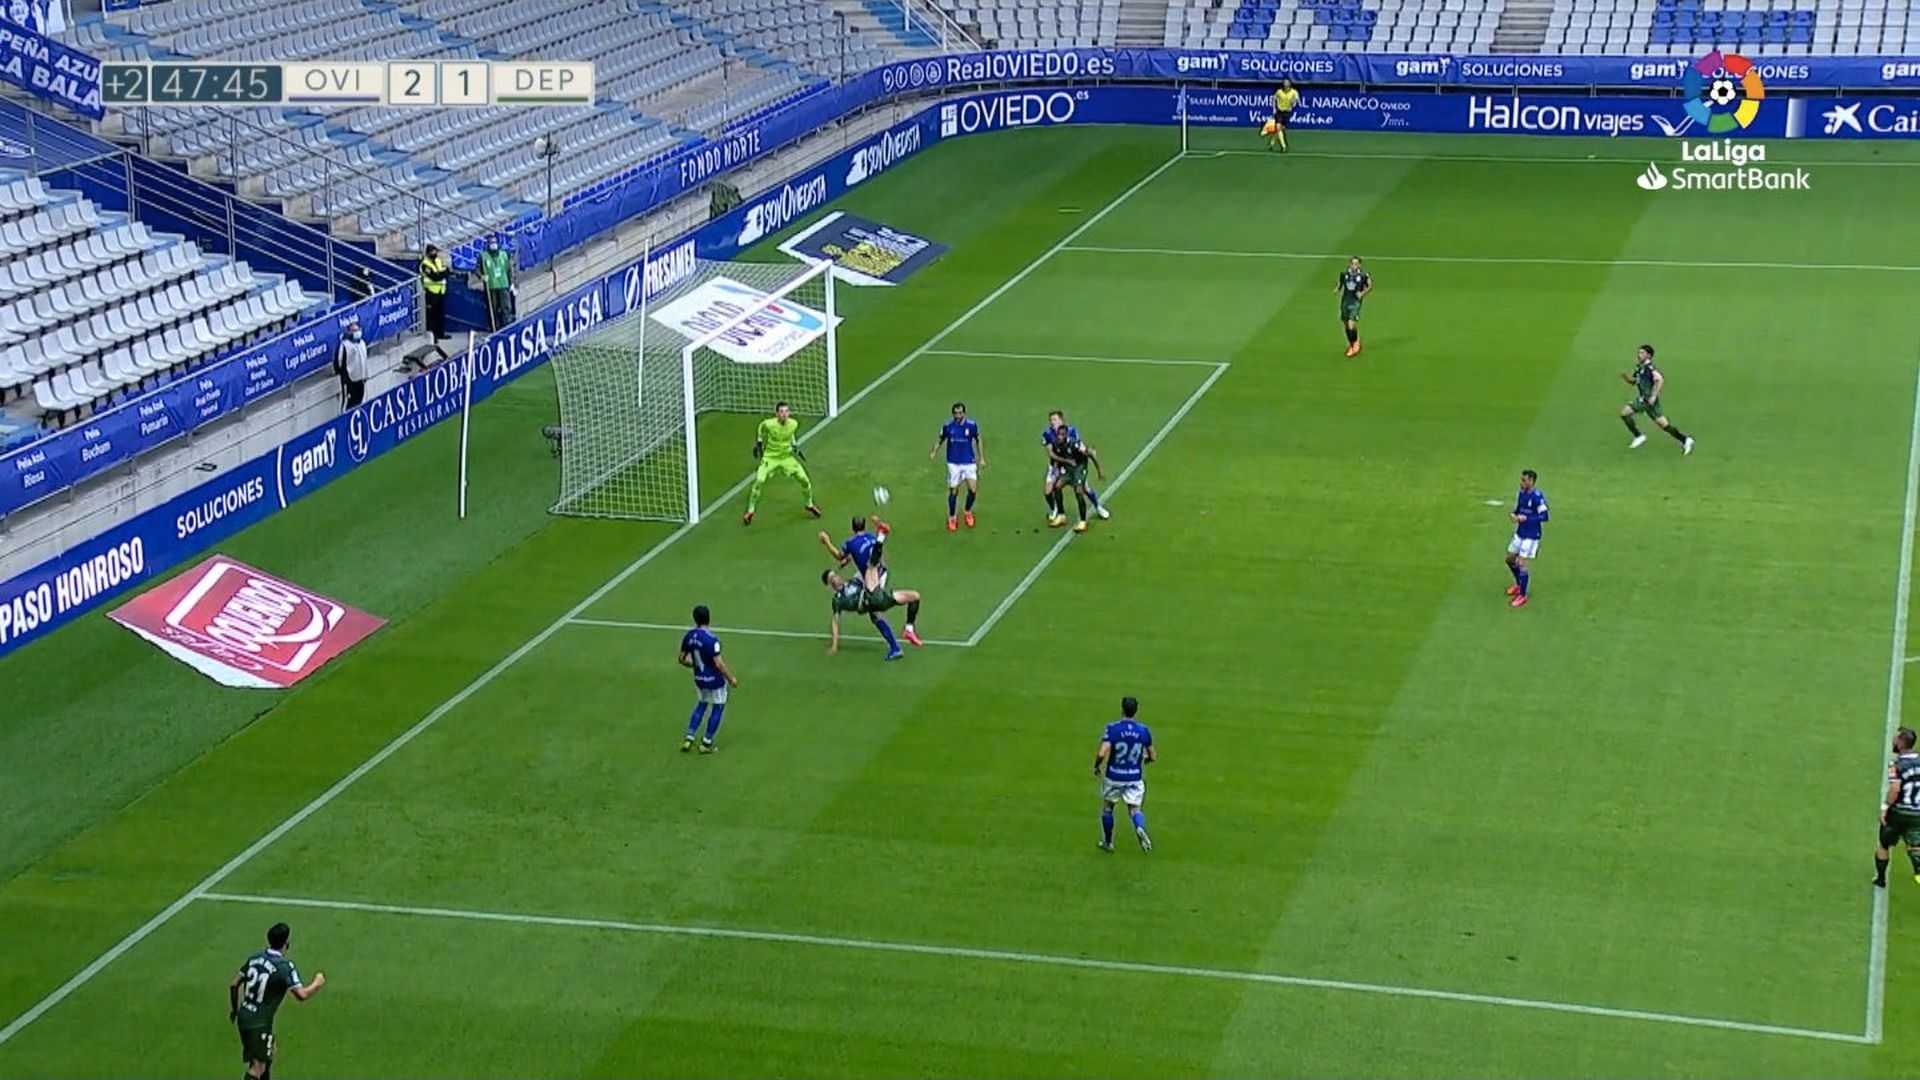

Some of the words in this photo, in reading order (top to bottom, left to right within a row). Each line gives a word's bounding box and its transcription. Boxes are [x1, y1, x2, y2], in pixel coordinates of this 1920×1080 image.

[0, 29, 49, 63] PEÑA
[55, 54, 101, 85] AZU
[947, 52, 1115, 83] RealOVIEDO.es
[1241, 58, 1334, 73] SOLUCIONES
[1462, 63, 1563, 77] SOLUCIONES
[1312, 95, 1379, 110] NARANCO
[1468, 96, 1580, 130] Halcon
[1584, 114, 1644, 137] viajes
[680, 146, 721, 188] FONDO
[724, 129, 761, 163] NORTE
[493, 318, 549, 381] ALSA
[553, 289, 604, 348] ALSA
[370, 382, 419, 433] CASA
[176, 476, 264, 538] SOLUCIONES
[0, 582, 53, 645] PASO
[56, 535, 144, 614] HONROSO
[1115, 741, 1143, 765] 24
[246, 966, 270, 1004] 21
